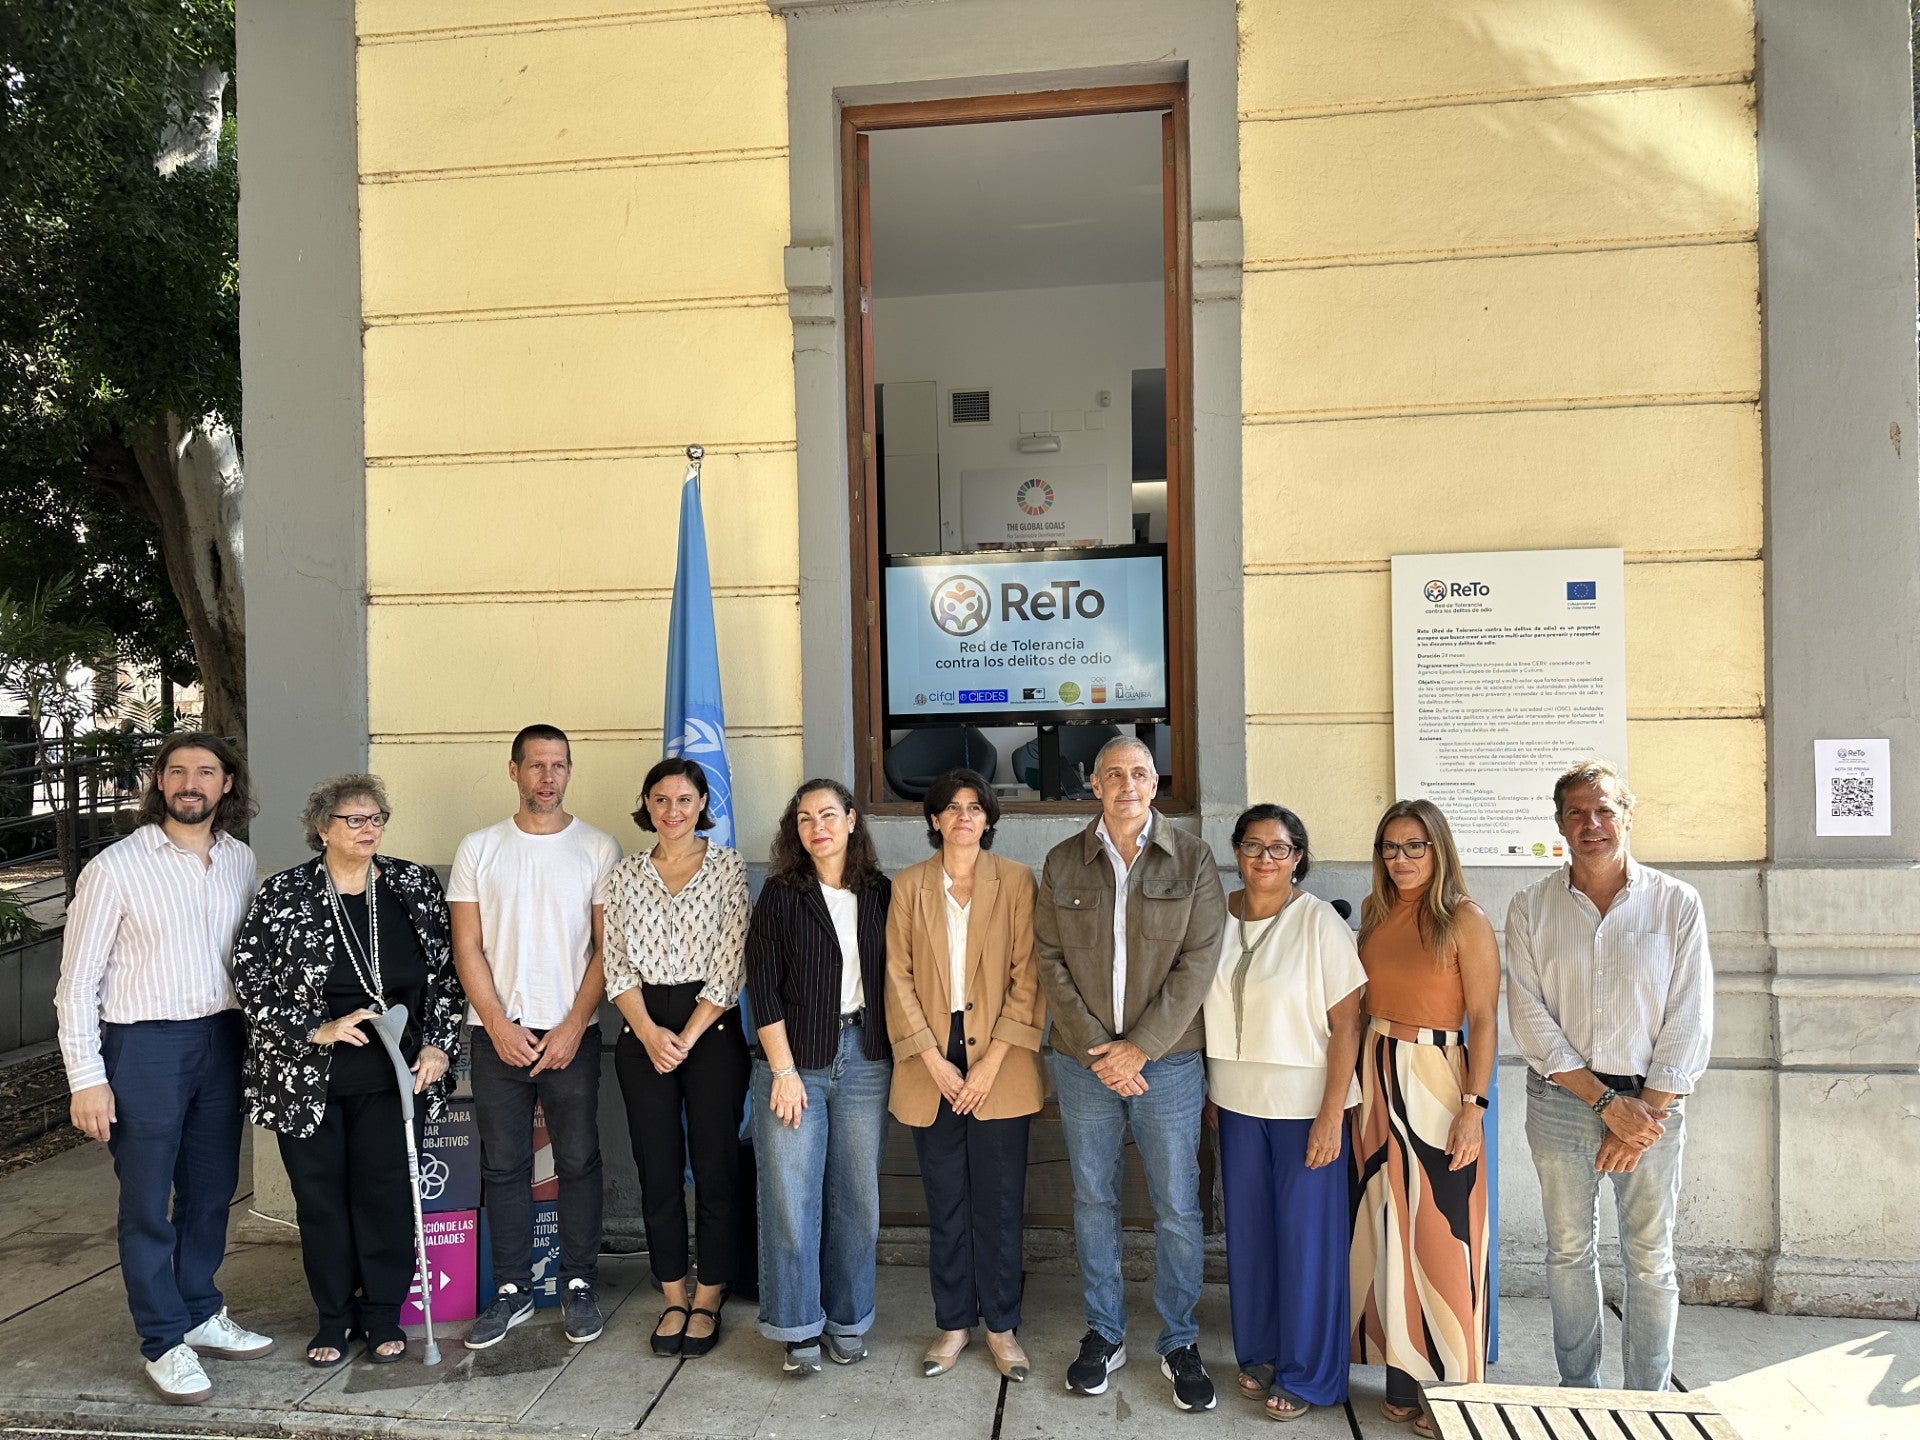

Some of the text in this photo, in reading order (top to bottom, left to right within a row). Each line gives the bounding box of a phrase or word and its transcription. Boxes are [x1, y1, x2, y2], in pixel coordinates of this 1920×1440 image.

[1006, 522, 1065, 531] THE GLOBAL GOALS
[1450, 582, 1490, 596] ReTo
[1001, 580, 1105, 621] ReTo
[960, 638, 1084, 653] Red de Tolerancia
[936, 652, 1111, 669] contra los delitos de odio
[929, 690, 955, 702] cifal
[968, 691, 1006, 702] CIEDES
[448, 1111, 471, 1122] PARA
[422, 1136, 469, 1149] OBJETIVOS
[447, 1221, 457, 1231] DE
[458, 1220, 473, 1230] LAS
[532, 1236, 550, 1248] DAS
